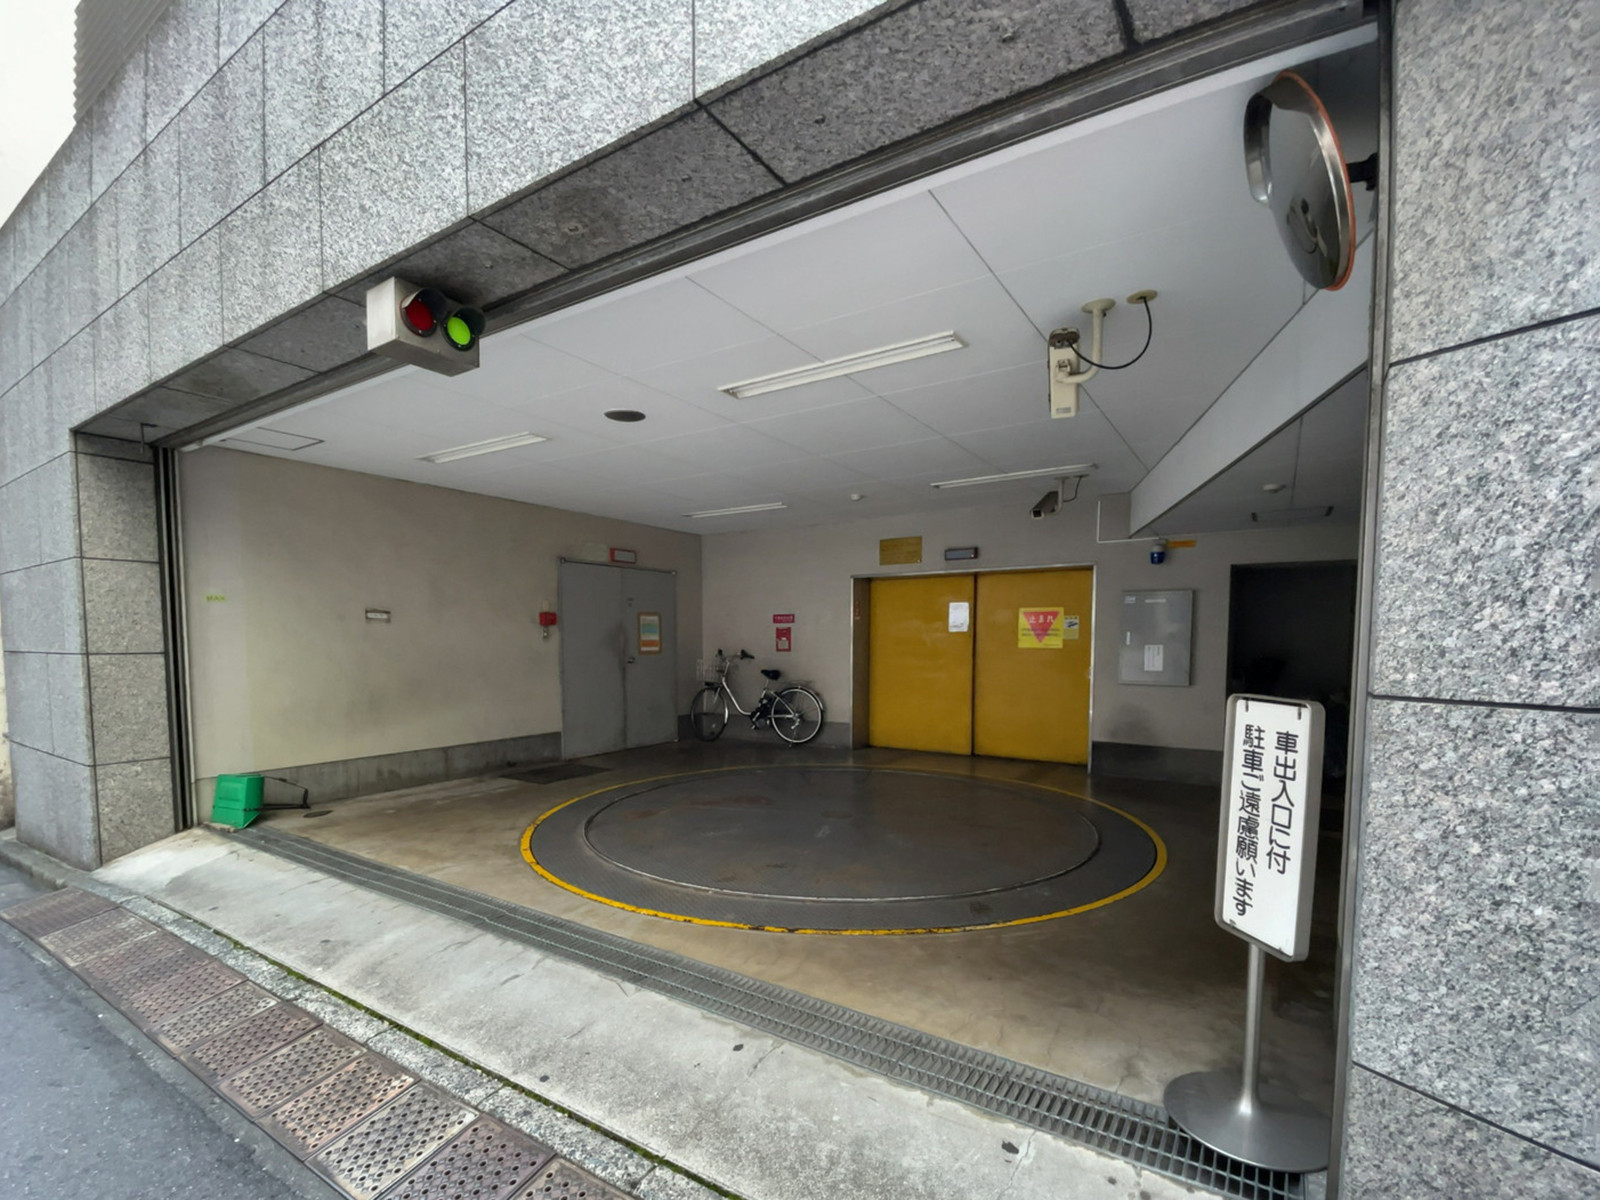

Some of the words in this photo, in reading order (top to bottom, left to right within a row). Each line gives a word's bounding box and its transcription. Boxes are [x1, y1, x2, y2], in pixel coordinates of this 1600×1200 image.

[1233, 724, 1266, 916] 駐車ご遠慮願います
[1266, 730, 1299, 875] 車出入口に付
